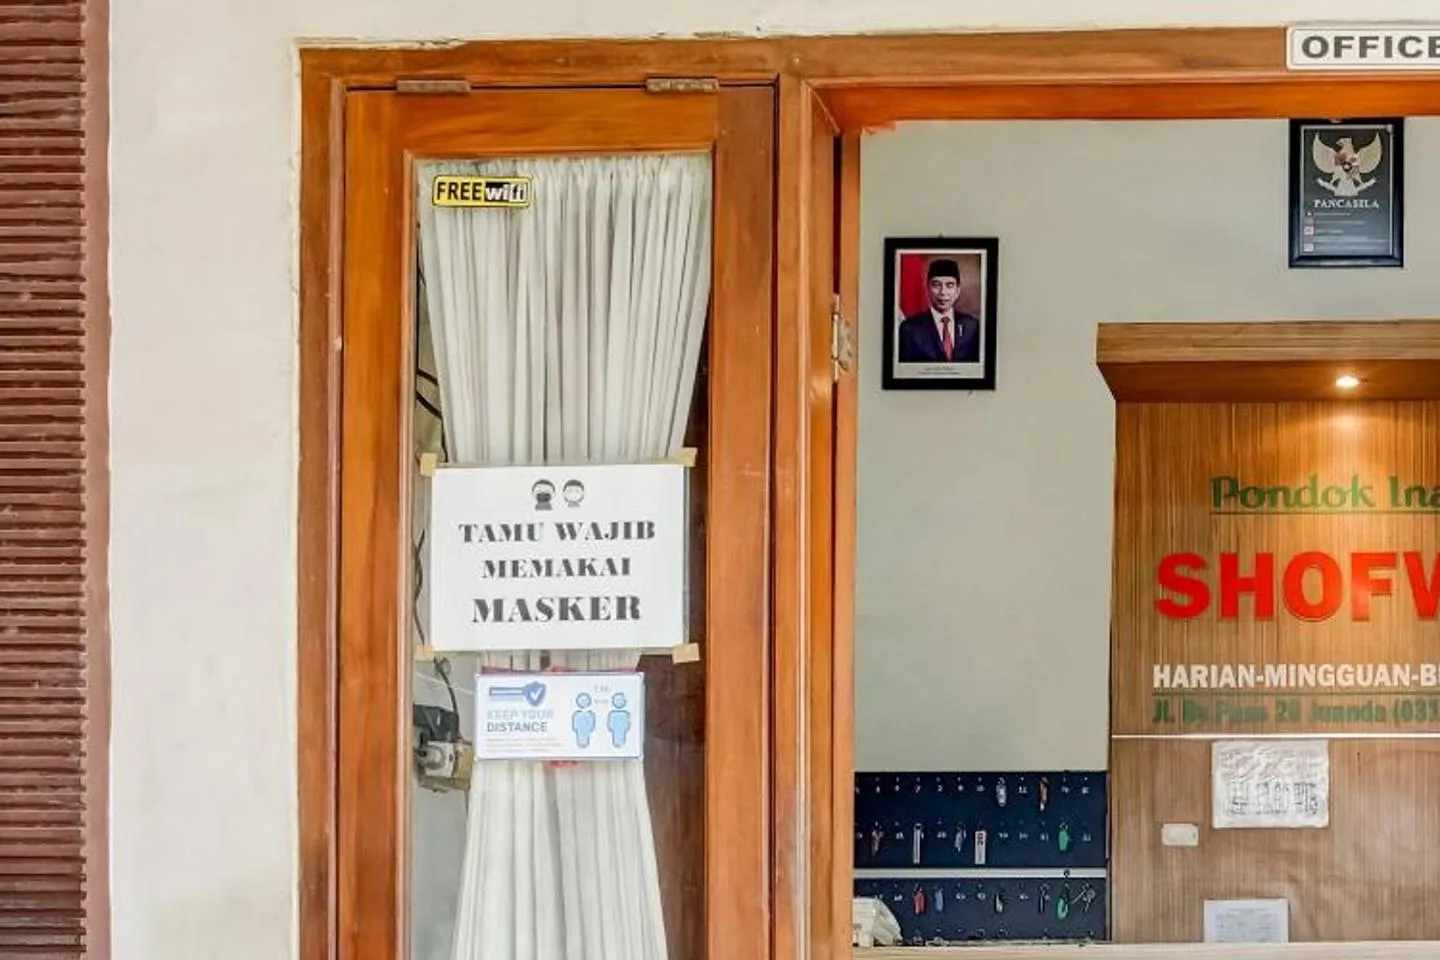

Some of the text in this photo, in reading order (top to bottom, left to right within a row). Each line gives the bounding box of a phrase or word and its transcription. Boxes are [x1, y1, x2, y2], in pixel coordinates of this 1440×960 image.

[436, 181, 525, 201] FREE wifi
[1314, 199, 1379, 208] PANCASILA
[1210, 474, 1374, 509] Pondok
[458, 520, 656, 543] TAMU WAJIB
[481, 557, 632, 579] MEMAKAI
[472, 595, 642, 623] MASKER
[486, 721, 548, 733] DISTANCE
